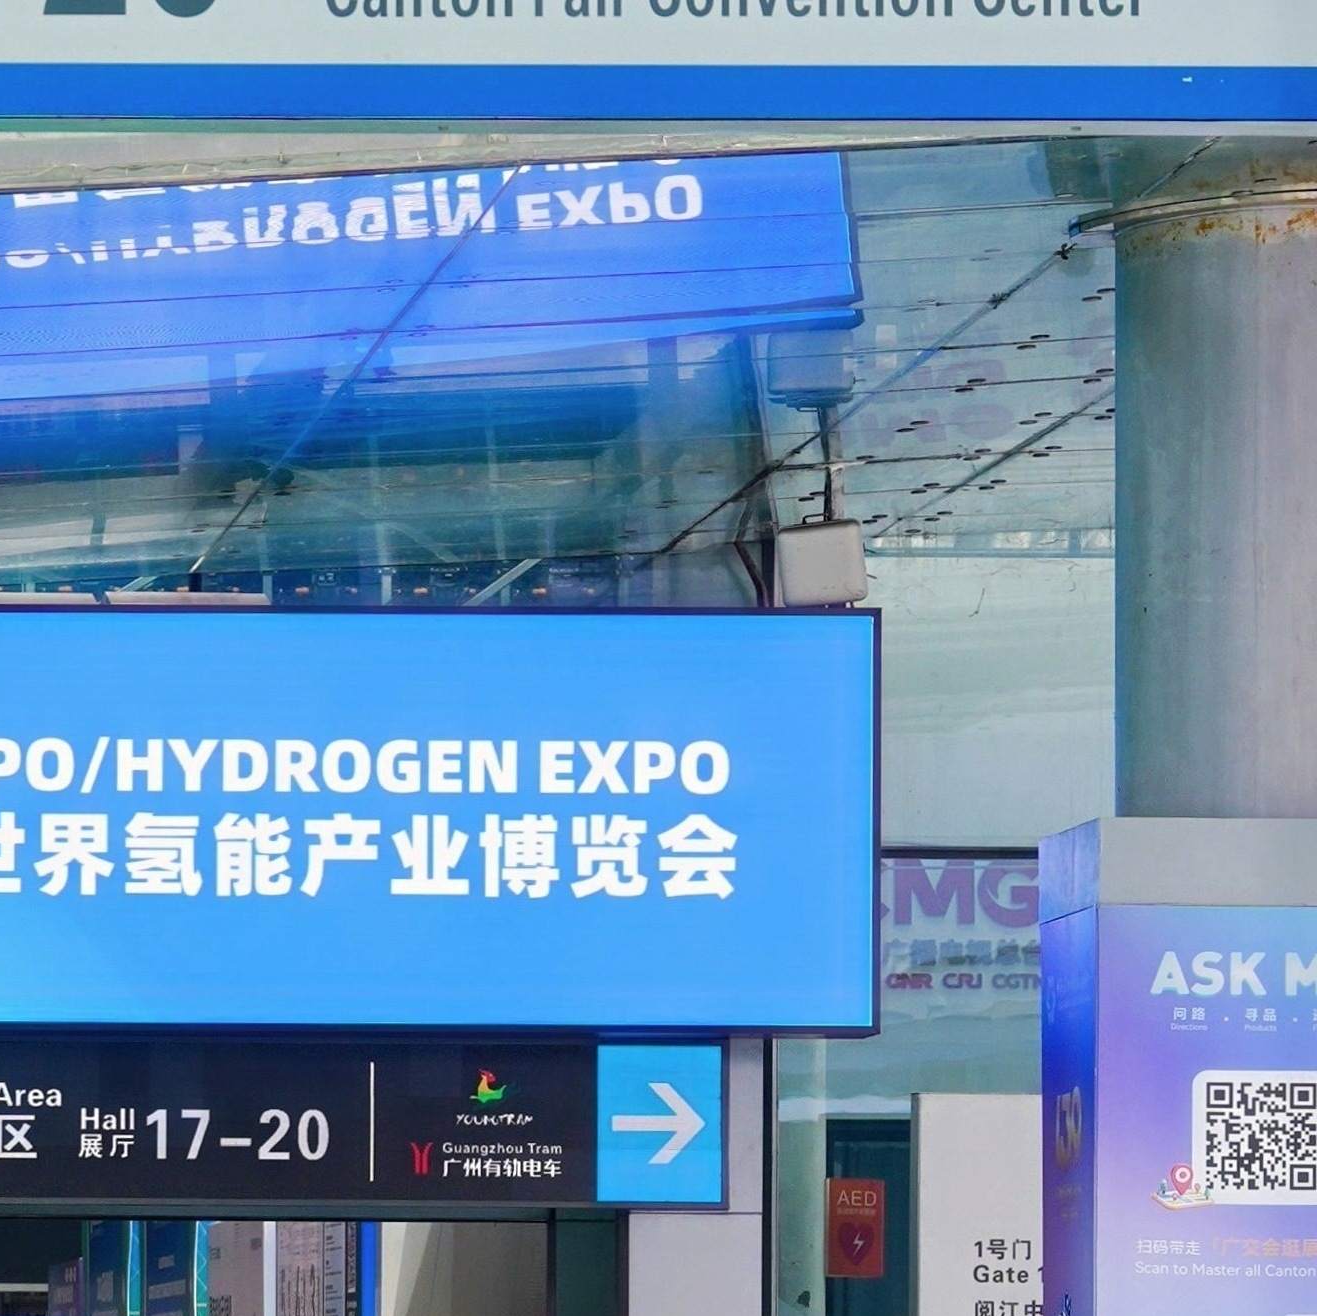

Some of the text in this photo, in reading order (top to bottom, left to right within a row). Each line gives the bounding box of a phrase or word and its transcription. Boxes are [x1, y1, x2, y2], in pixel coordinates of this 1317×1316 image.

[540, 740, 732, 796] EXPO
[881, 859, 1039, 928] MG
[1150, 950, 1317, 996] ASK M
[80, 1107, 135, 1131] Hall
[78, 1134, 136, 1159] 展厅
[442, 1142, 563, 1157] Guangzhou Tram
[442, 1158, 563, 1178] 广州有轨电车
[837, 1190, 877, 1207] AED
[974, 1238, 1031, 1261] 1号门
[1136, 1238, 1201, 1256] 扫码带走
[973, 1264, 1029, 1284] Gate
[1134, 1261, 1316, 1278] Scan to Master all Canton
